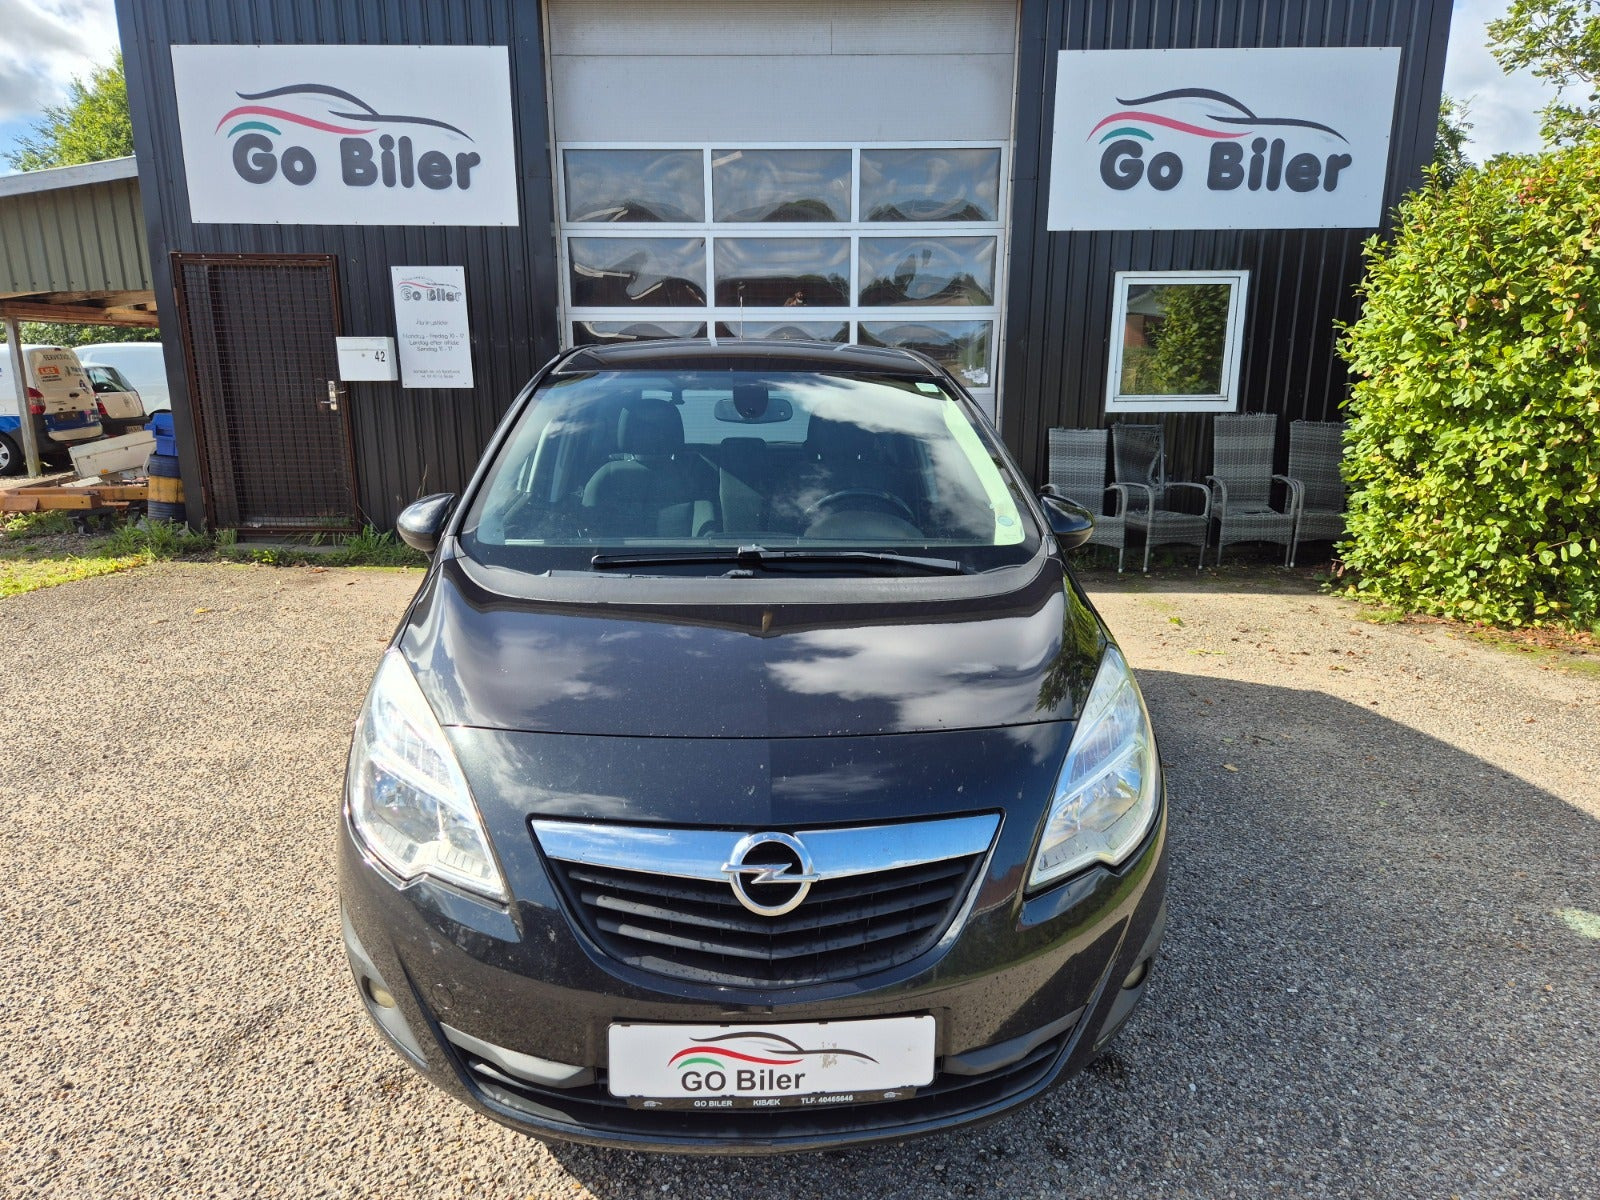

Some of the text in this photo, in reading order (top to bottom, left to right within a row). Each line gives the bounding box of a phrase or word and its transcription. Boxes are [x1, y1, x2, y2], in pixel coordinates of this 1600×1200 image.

[232, 133, 482, 191] Go Biler
[1099, 137, 1353, 193] Go Biler
[401, 287, 462, 302] Go Biler
[374, 351, 386, 362] 42
[681, 1069, 805, 1092] GO Biler
[753, 1098, 780, 1106] KIBÆK
[801, 1097, 817, 1105] TLF.
